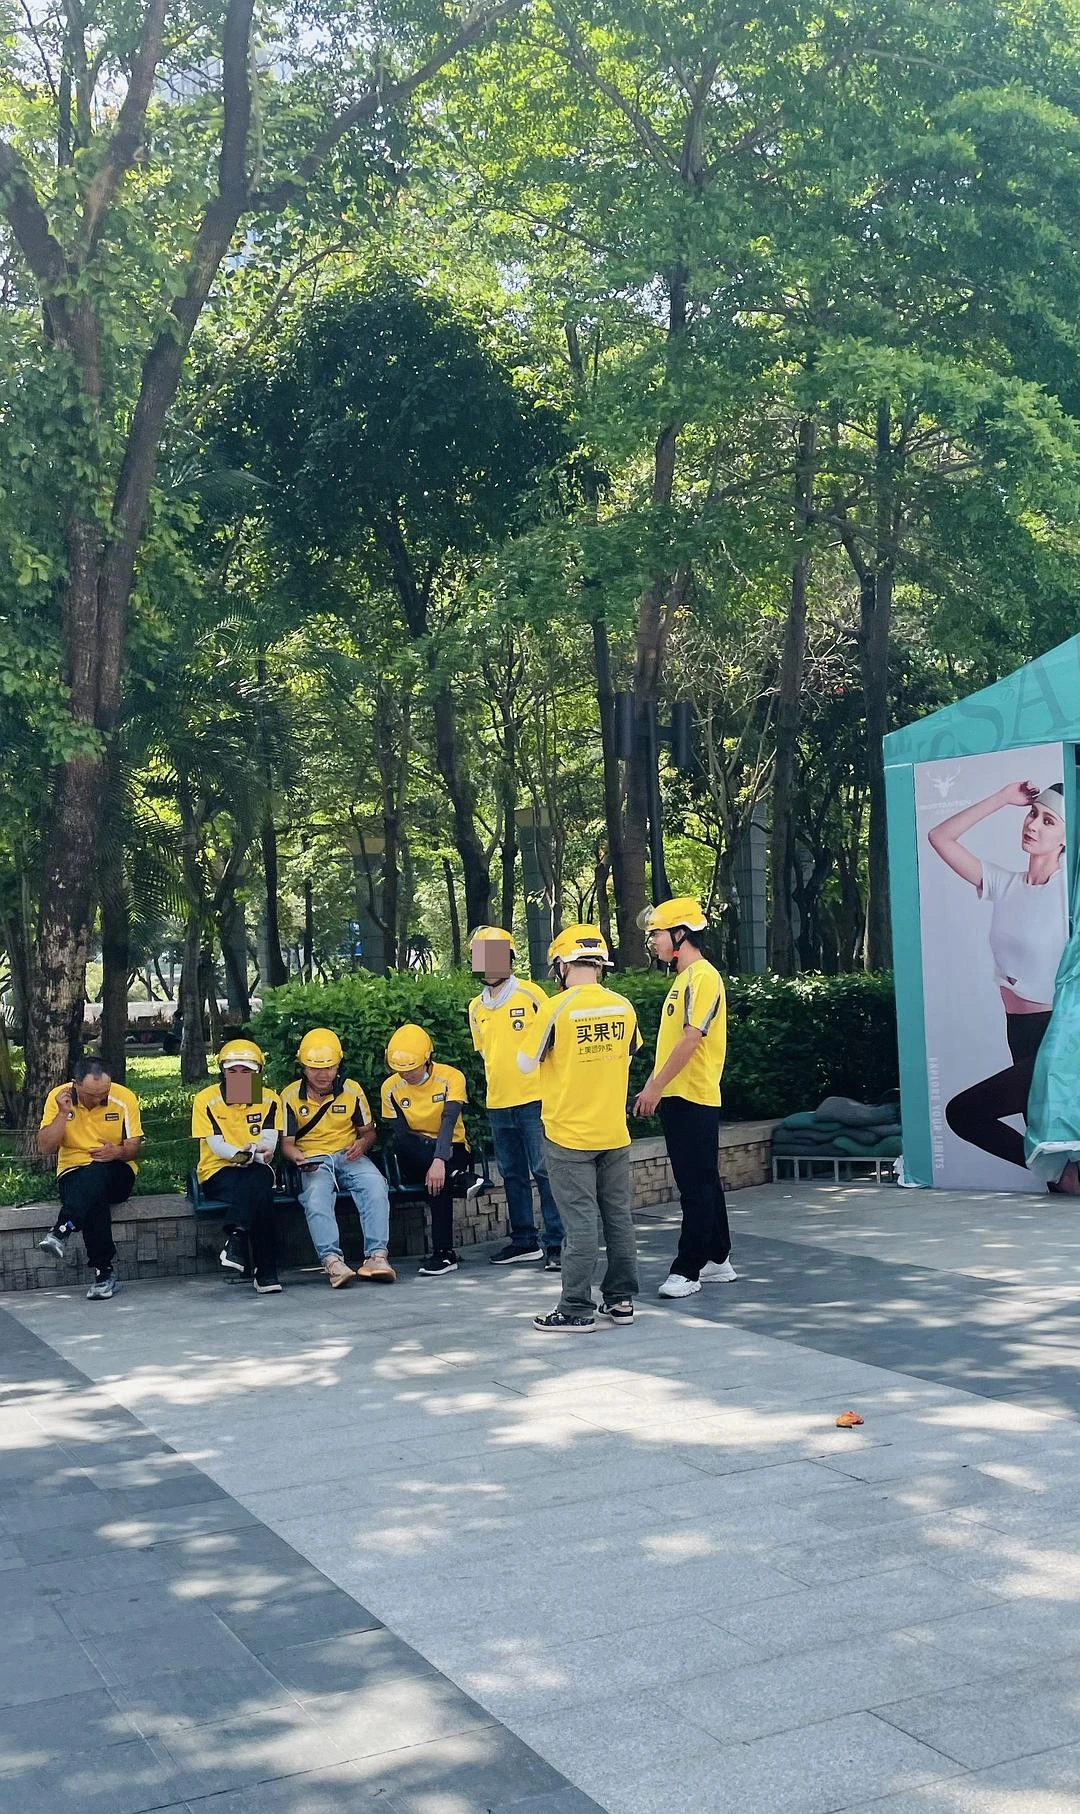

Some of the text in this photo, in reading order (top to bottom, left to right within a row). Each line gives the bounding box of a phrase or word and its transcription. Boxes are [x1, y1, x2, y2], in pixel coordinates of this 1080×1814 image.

[576, 1021, 625, 1044] 买果切
[932, 1104, 942, 1132] YOUR
